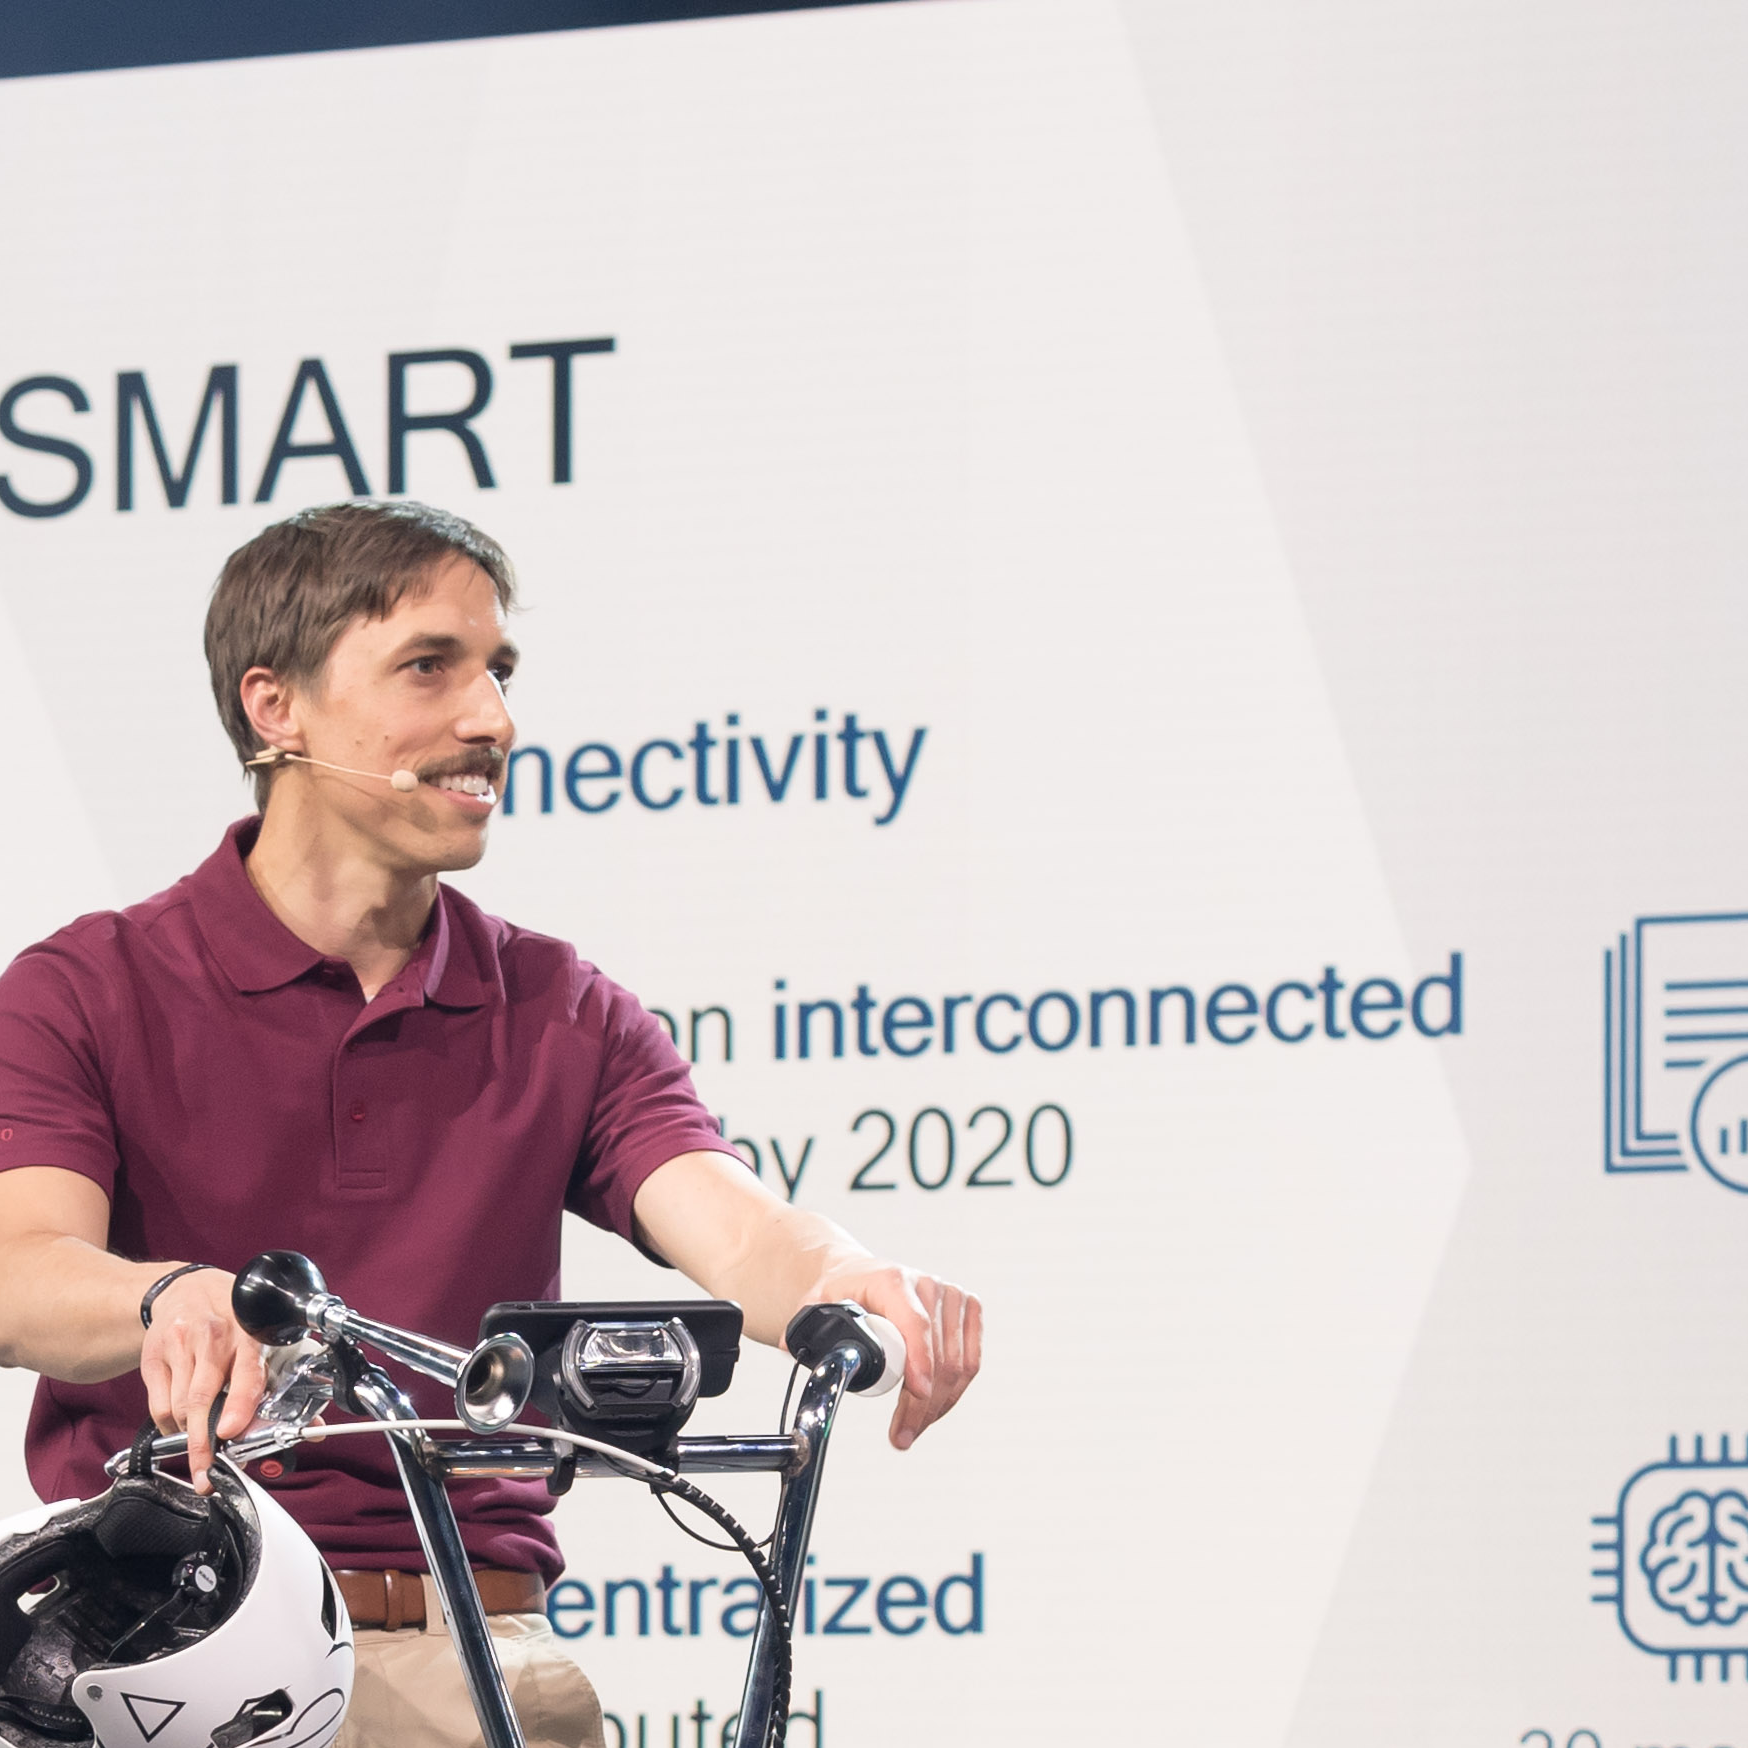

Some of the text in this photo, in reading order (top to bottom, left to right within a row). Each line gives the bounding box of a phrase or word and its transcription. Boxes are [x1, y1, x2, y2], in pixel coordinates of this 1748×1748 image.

[501, 708, 928, 826] nectivity
[773, 951, 1463, 1062] interconnected
[848, 1103, 1074, 1192] 2020
